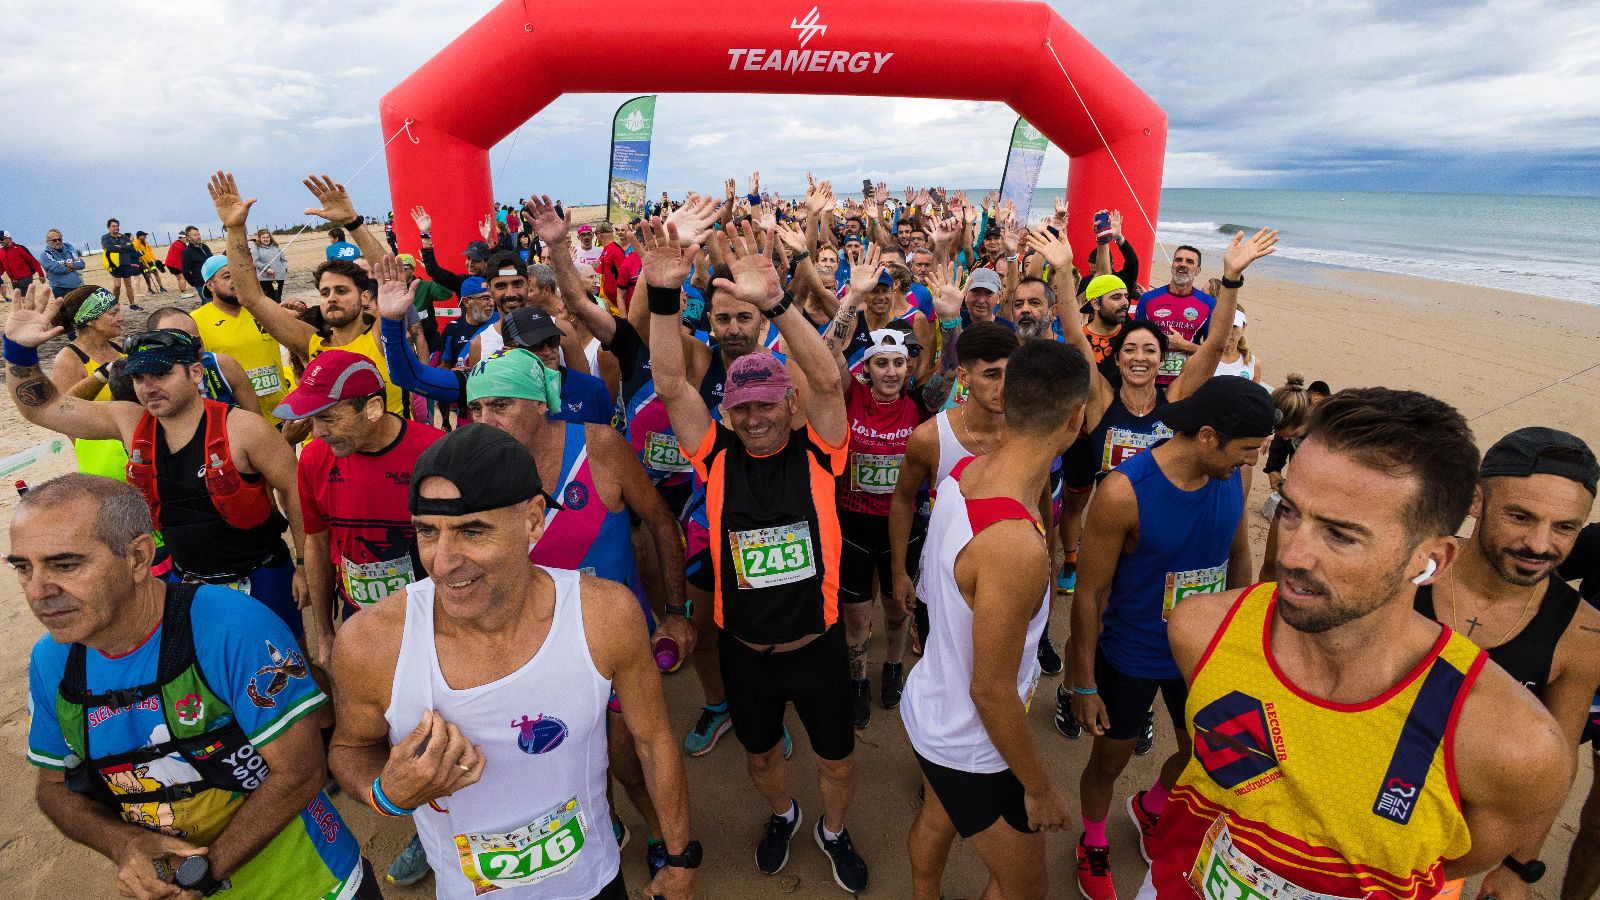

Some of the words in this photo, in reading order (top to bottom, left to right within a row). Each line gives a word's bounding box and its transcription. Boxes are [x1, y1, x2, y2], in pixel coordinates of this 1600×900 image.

[727, 48, 894, 76] TEAMERGY
[252, 374, 277, 390] 280
[861, 467, 900, 485] 240
[746, 543, 805, 575] 243
[1264, 702, 1288, 762] RECOSUR
[221, 744, 254, 767] YO
[489, 828, 577, 879] 276
